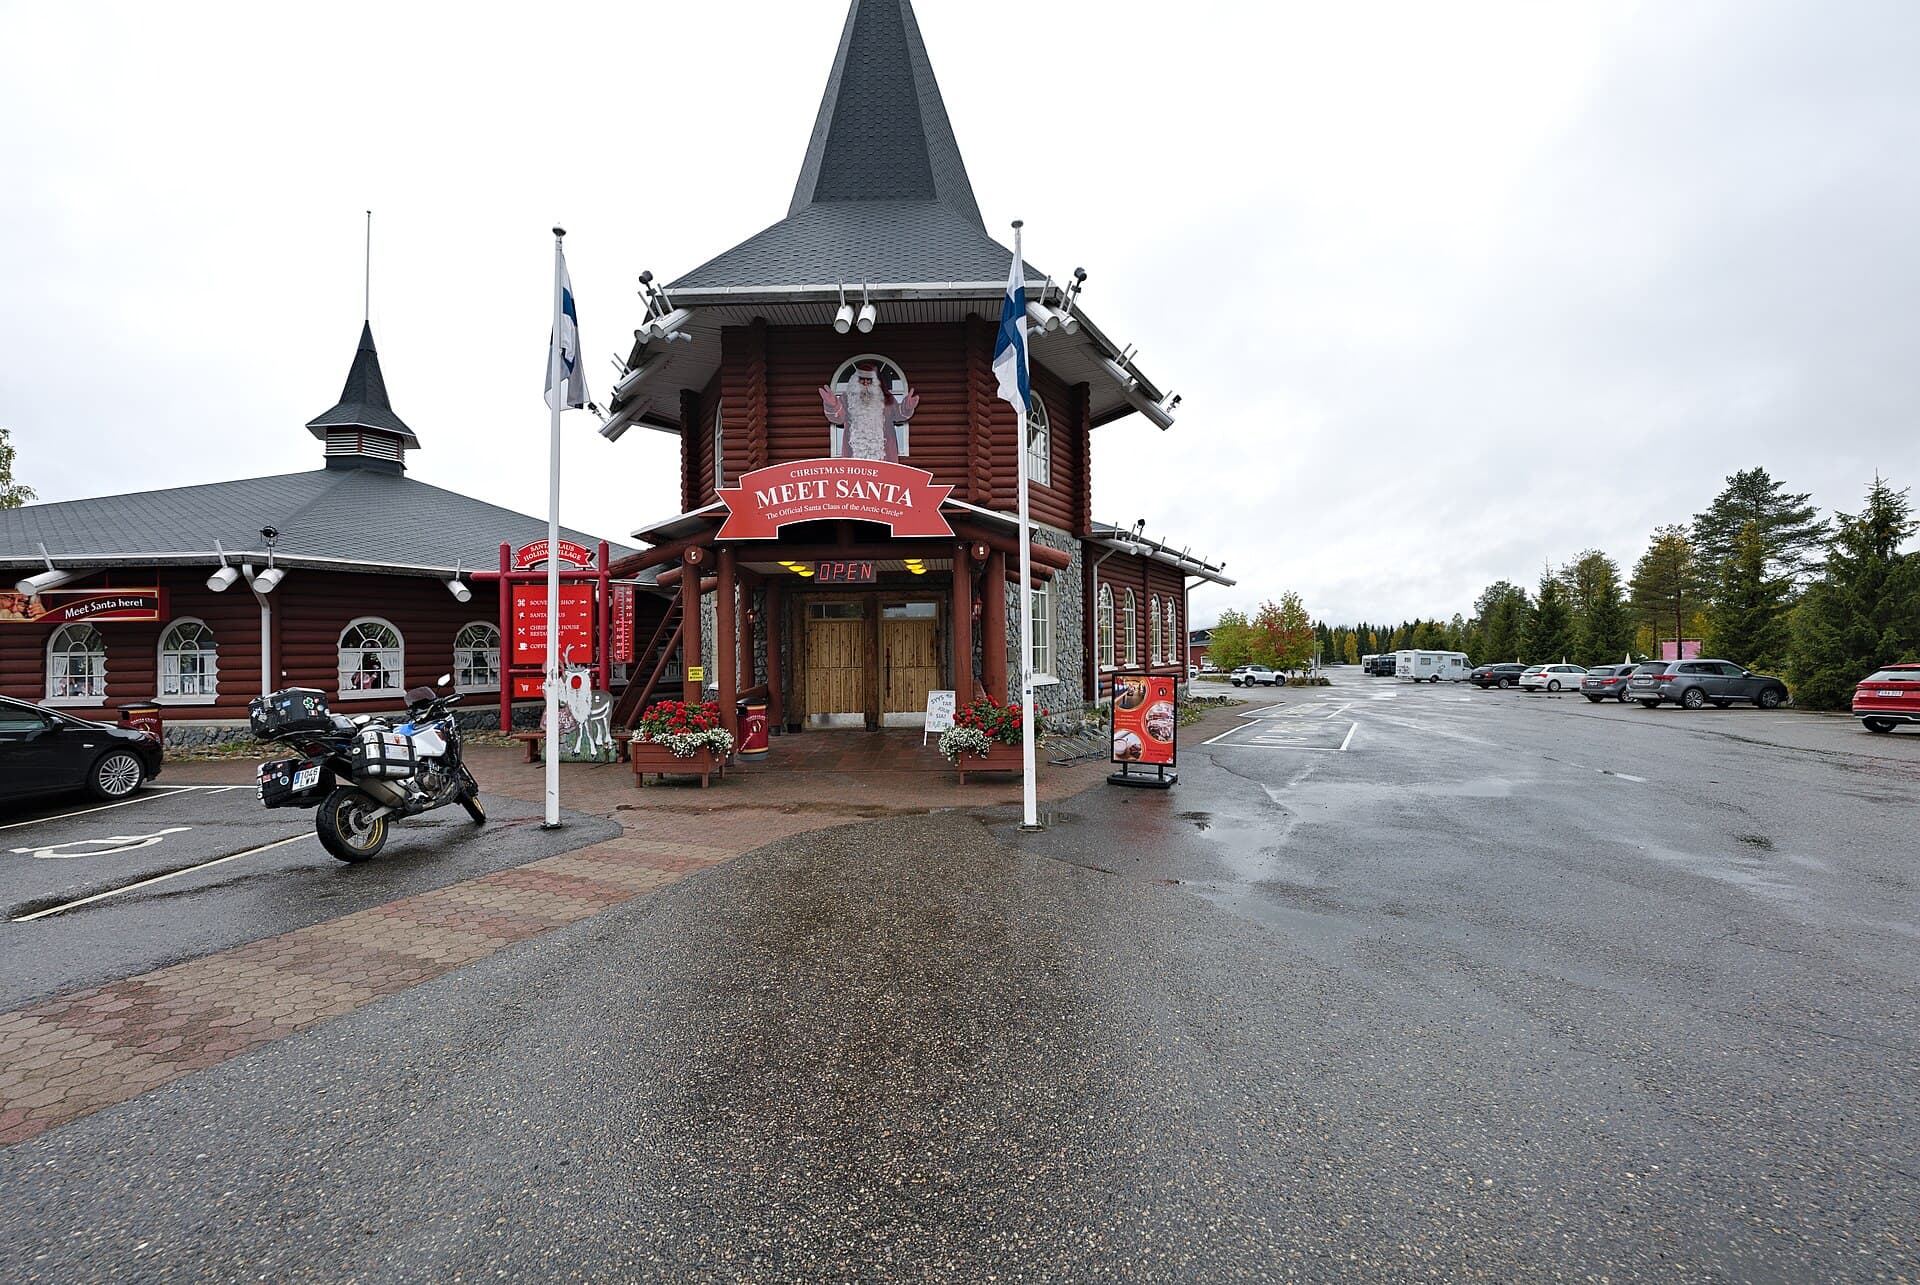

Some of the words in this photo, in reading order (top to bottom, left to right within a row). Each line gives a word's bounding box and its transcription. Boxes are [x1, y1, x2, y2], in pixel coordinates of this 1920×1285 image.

[790, 466, 845, 478] CHRISTMAS
[847, 467, 879, 478] HOUSE
[754, 479, 830, 509] MEET
[835, 479, 914, 508] SANTA
[779, 506, 803, 517] Official
[849, 503, 860, 511] the
[860, 505, 880, 513] Arctic
[530, 543, 549, 553] SANT
[558, 543, 575, 552] LAUS
[523, 549, 549, 562] HOLIDA
[819, 563, 872, 580] OPEN
[65, 604, 90, 620] Meet
[90, 600, 117, 612] Santa
[118, 598, 143, 607] here!
